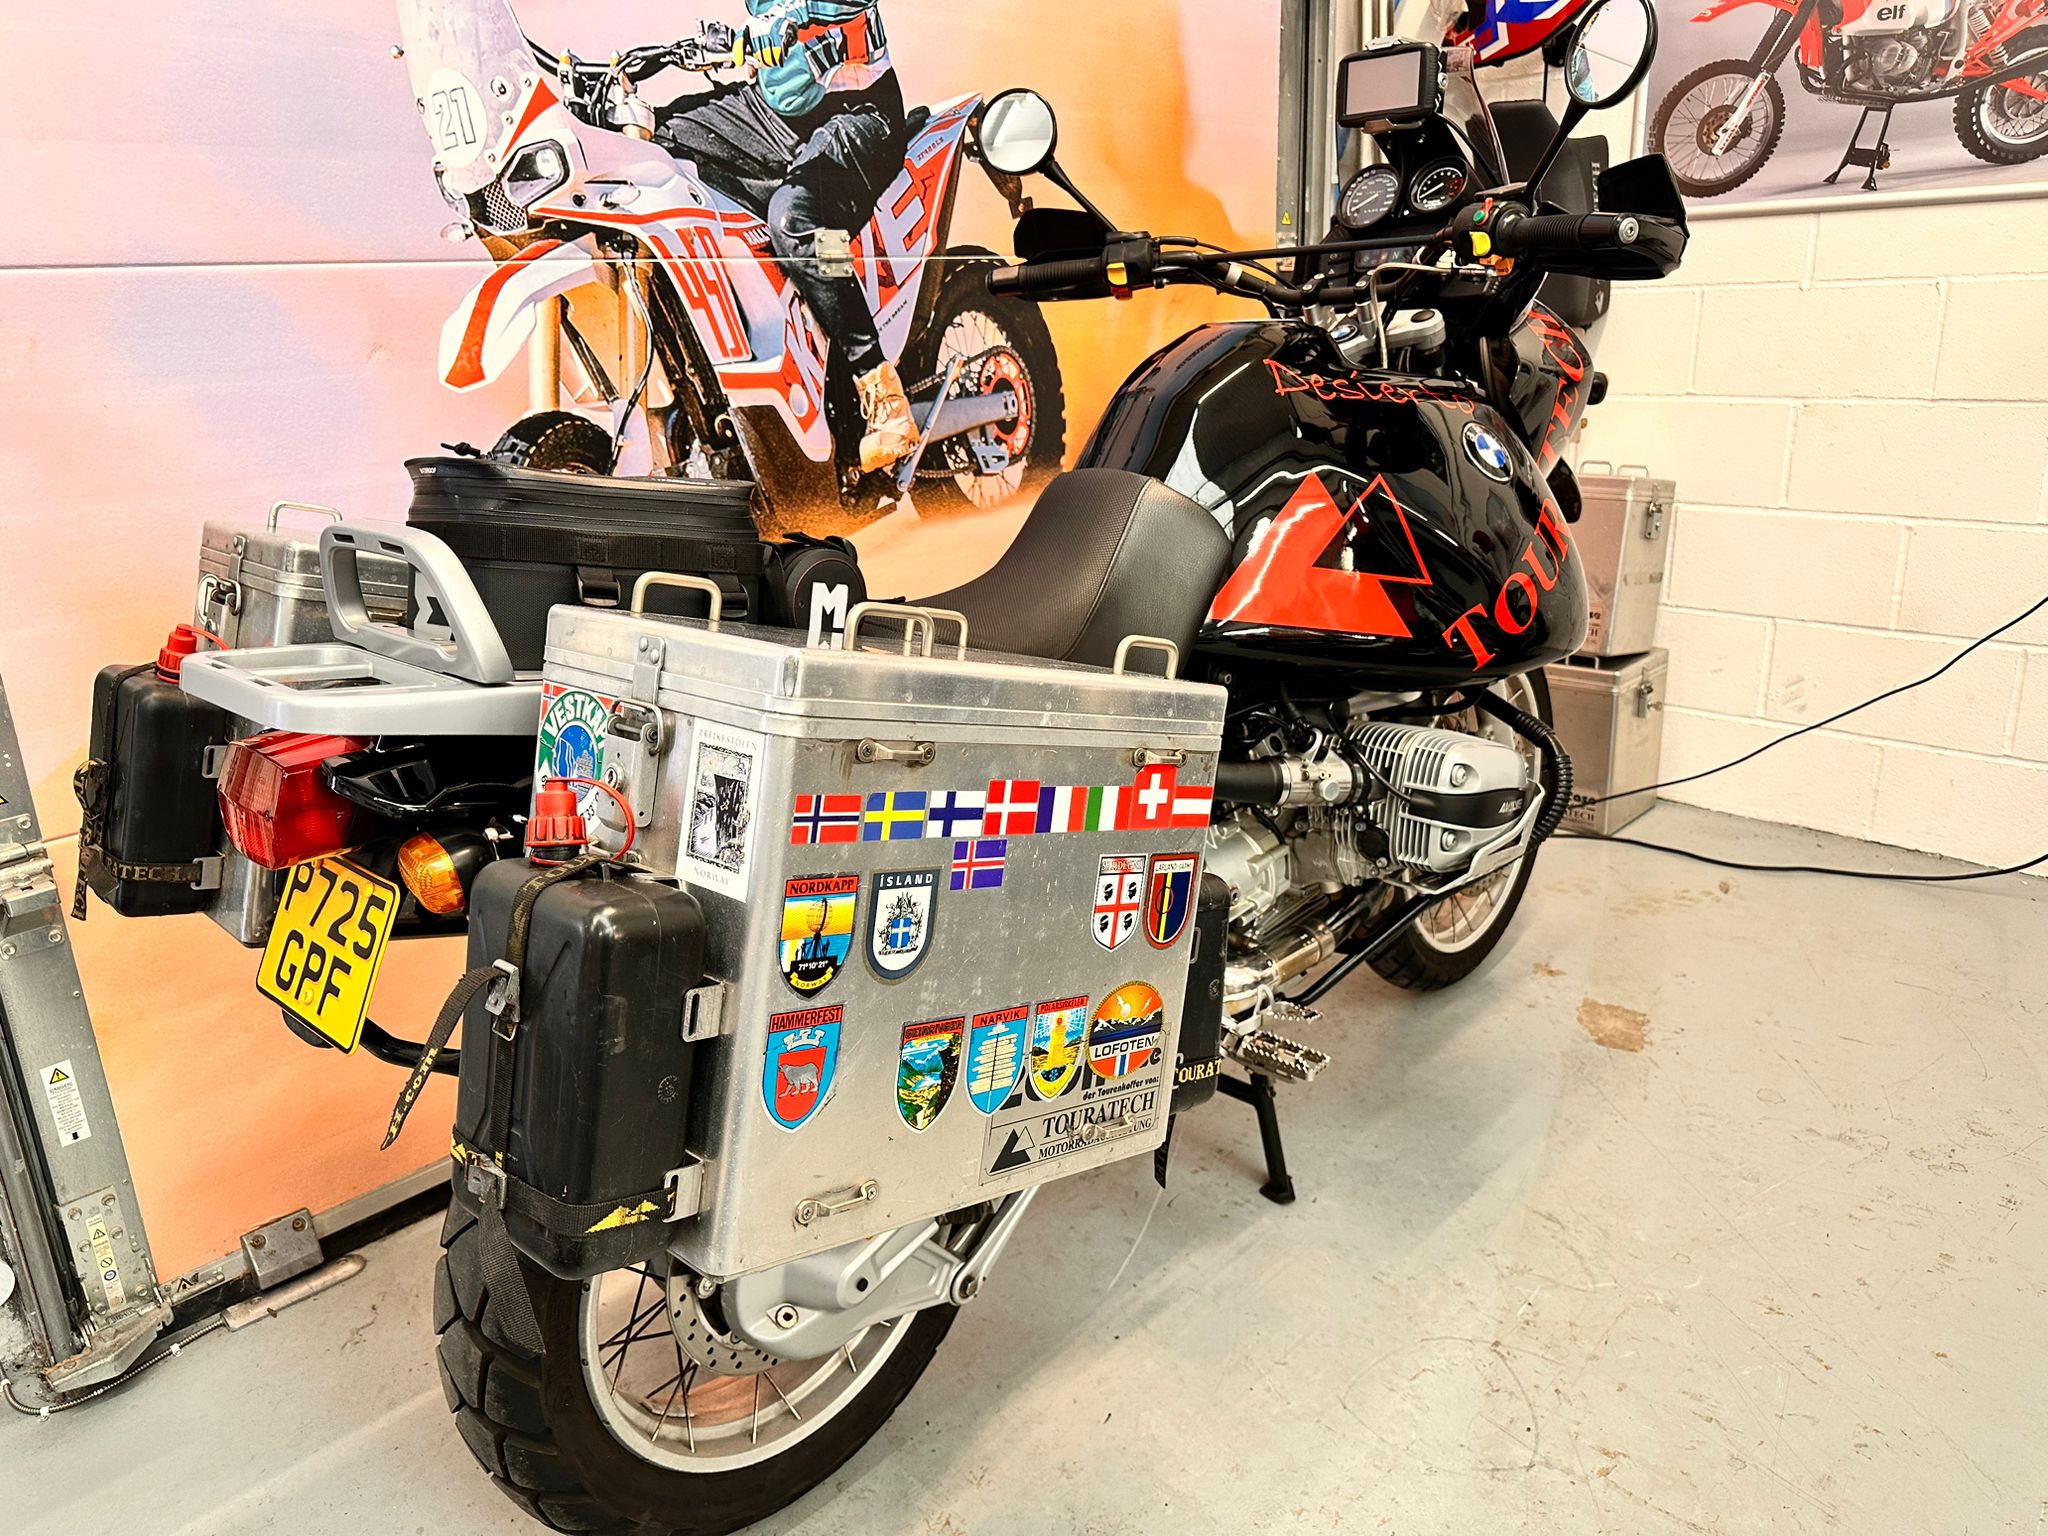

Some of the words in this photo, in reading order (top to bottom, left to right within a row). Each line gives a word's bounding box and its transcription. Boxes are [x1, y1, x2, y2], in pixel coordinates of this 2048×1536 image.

[1877, 3, 1906, 21] elf
[432, 86, 477, 151] 21
[647, 225, 750, 359] 450
[1263, 357, 1475, 415] Desierto
[1442, 498, 1571, 672] TOUR
[790, 879, 855, 895] NORDKAPP
[879, 873, 934, 888] ÍSLAND
[285, 861, 387, 960] P725
[275, 929, 352, 1016] GPF
[795, 976, 828, 988] NORWAY
[771, 1006, 842, 1031] HAMMERFEST
[980, 1009, 1020, 1026] NARVIK
[1094, 1035, 1156, 1059] LOFOTEN
[1083, 1090, 1097, 1101] der
[1097, 1079, 1144, 1098] Tourenkoffer
[1144, 1075, 1160, 1086] von:
[1042, 1090, 1155, 1138] TOURATECH
